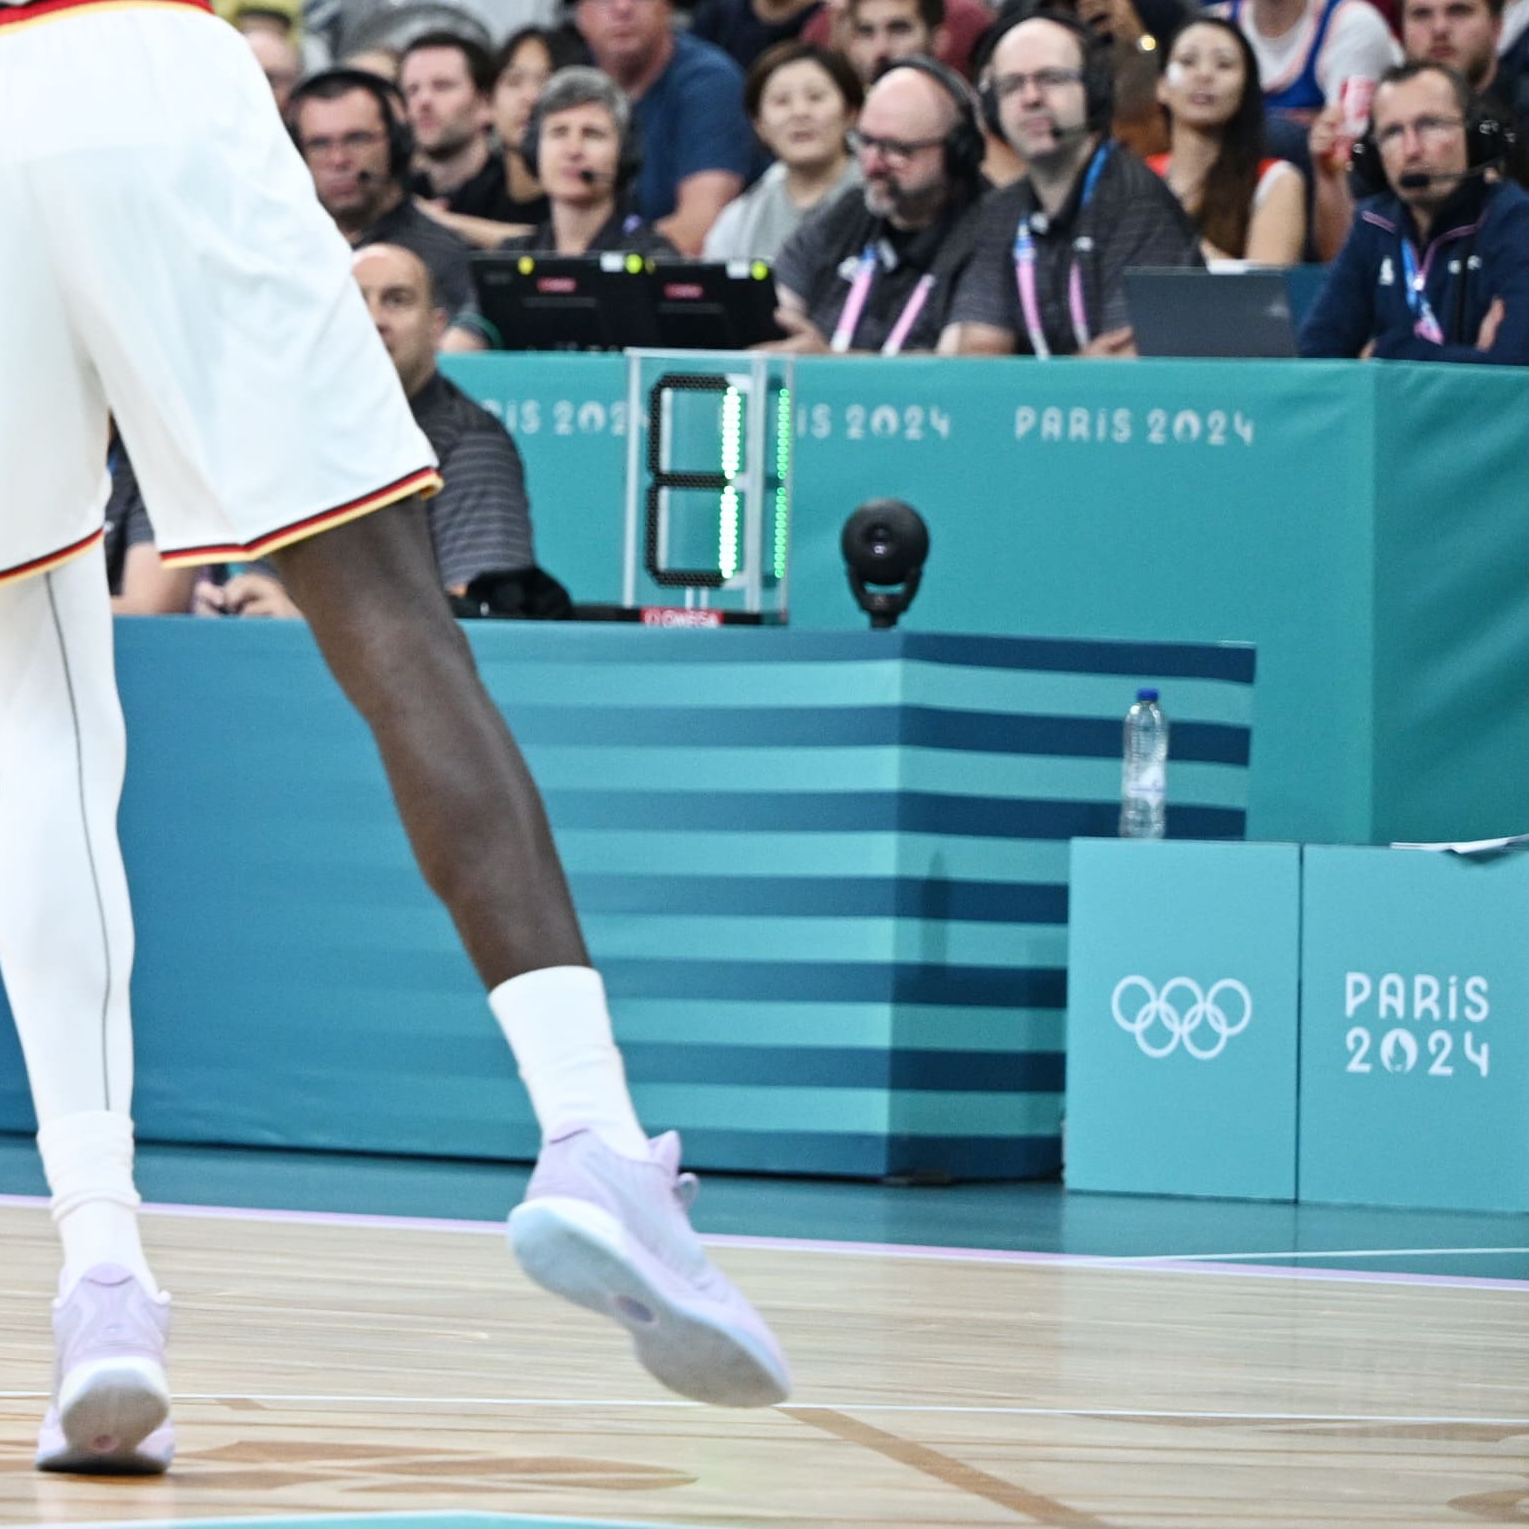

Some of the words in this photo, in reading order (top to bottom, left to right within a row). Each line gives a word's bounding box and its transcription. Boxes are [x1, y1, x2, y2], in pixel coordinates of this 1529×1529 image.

[845, 404, 951, 441] 2024
[1147, 408, 1254, 446] 2024
[1345, 1027, 1490, 1078] 2024
